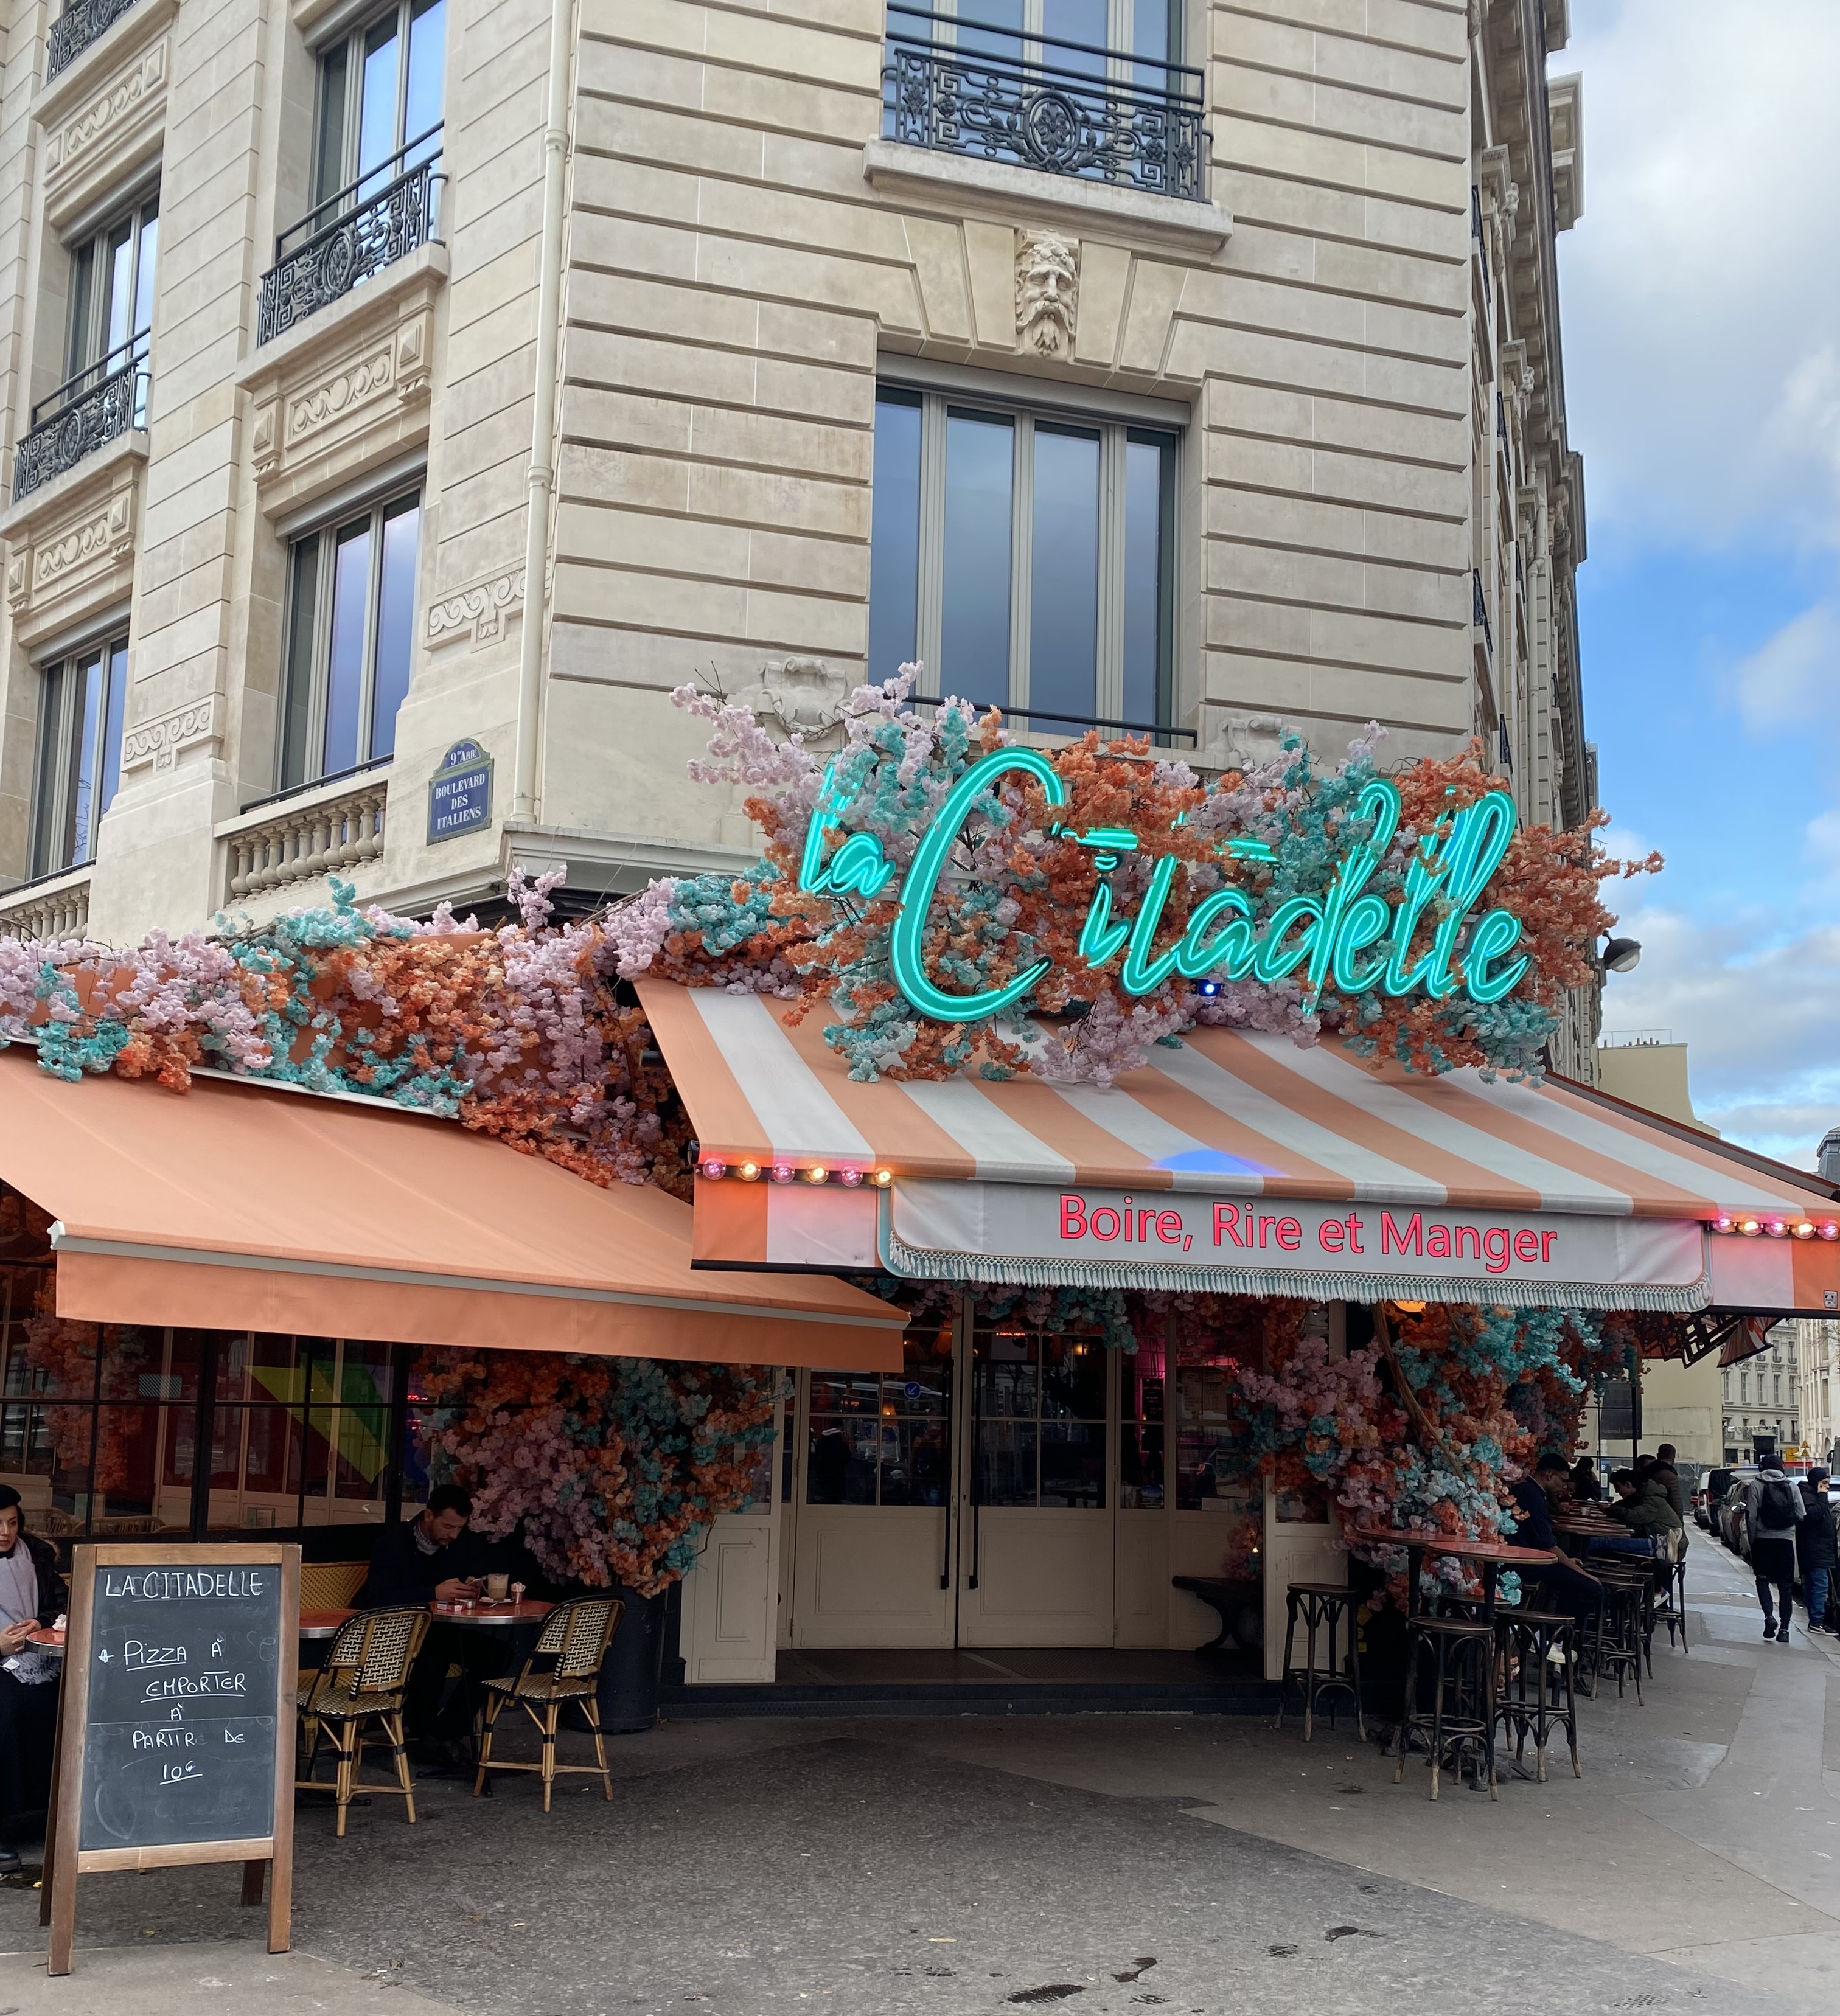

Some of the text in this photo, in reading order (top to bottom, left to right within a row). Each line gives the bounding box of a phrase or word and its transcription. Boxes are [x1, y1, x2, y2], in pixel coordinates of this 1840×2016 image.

[436, 773, 485, 799] BOULEVARD
[451, 794, 469, 810] DES
[437, 806, 481, 830] ITALIENS
[1059, 1194, 1558, 1273] Boire, Rire et Manger
[105, 1571, 263, 1599] LA CITADELLE
[145, 1671, 246, 1697] EMPORTER
[170, 1703, 183, 1720] À
[133, 1728, 245, 1749] PARTIR DE
